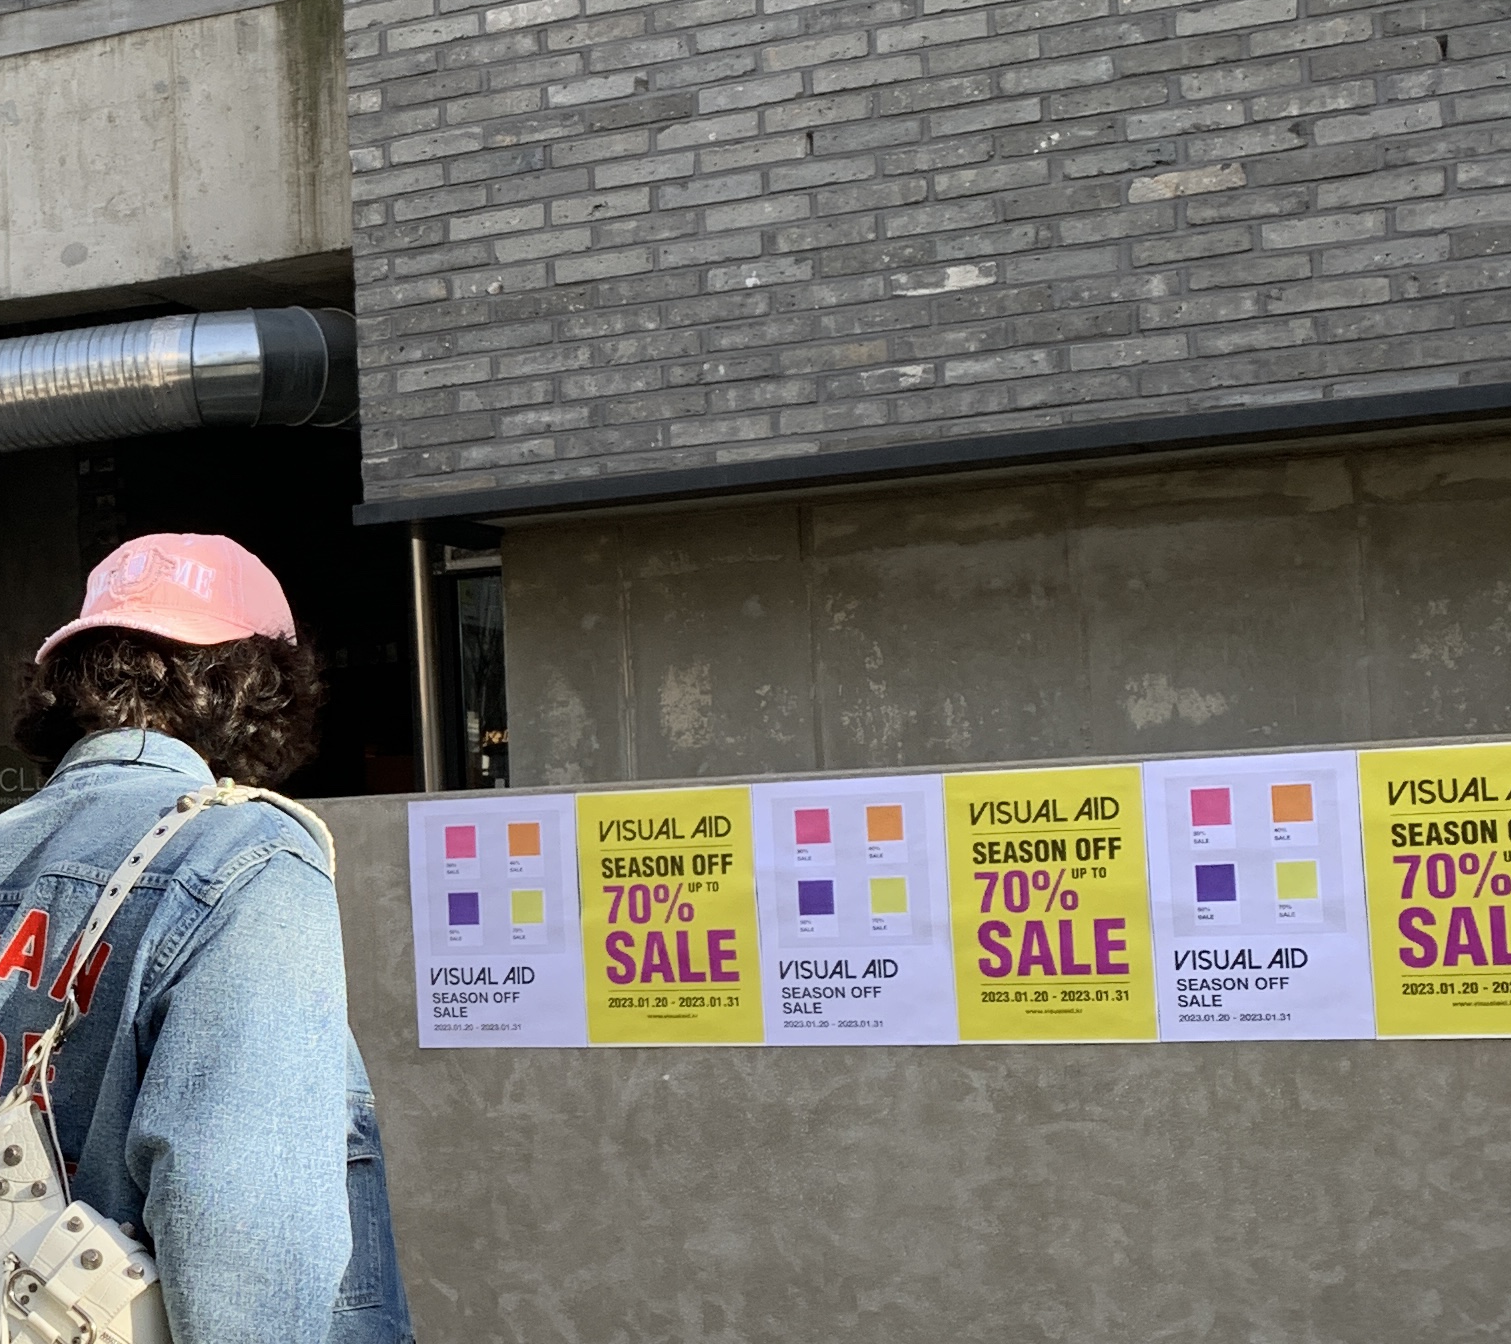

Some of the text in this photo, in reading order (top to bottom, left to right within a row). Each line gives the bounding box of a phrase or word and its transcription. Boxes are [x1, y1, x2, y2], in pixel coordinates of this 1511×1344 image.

[0, 767, 43, 792] CL
[1388, 776, 1499, 806] VISUAL
[969, 796, 1120, 826] VISUAL AID
[599, 815, 732, 842] VISUAL AID
[1391, 819, 1498, 848] SEASON
[972, 837, 1122, 865] SEASON OFF
[601, 853, 733, 879] SEASON OFF
[1071, 867, 1107, 879] UP TO
[1392, 850, 1511, 900] 70%
[688, 881, 719, 893] UP TO
[974, 868, 1079, 913] 70%
[602, 883, 694, 924] 70%
[977, 918, 1130, 978] SALE
[1398, 905, 1511, 969] SAL
[605, 929, 740, 985] SALE
[1174, 947, 1308, 971] VISUAL AID
[430, 966, 535, 986] VISUAL AID
[779, 958, 898, 979] VISUAL AID
[781, 986, 882, 999] SEASON OFF
[1176, 976, 1290, 991] SEASON OFF
[1401, 982, 1479, 995] 2023.01.20
[432, 991, 521, 1004] SEASON OFF
[608, 997, 668, 1008] 2023.01.20
[679, 996, 740, 1007] 2023.01.31
[981, 991, 1049, 1003] 2023.01.20
[1060, 989, 1130, 1002] 2023.01.31
[1177, 994, 1223, 1007] SALE
[433, 1006, 468, 1018] SALE
[782, 1002, 823, 1014] SALE
[1178, 1014, 1230, 1022] 2023.01.20
[1239, 1013, 1291, 1022] 2023.01.31
